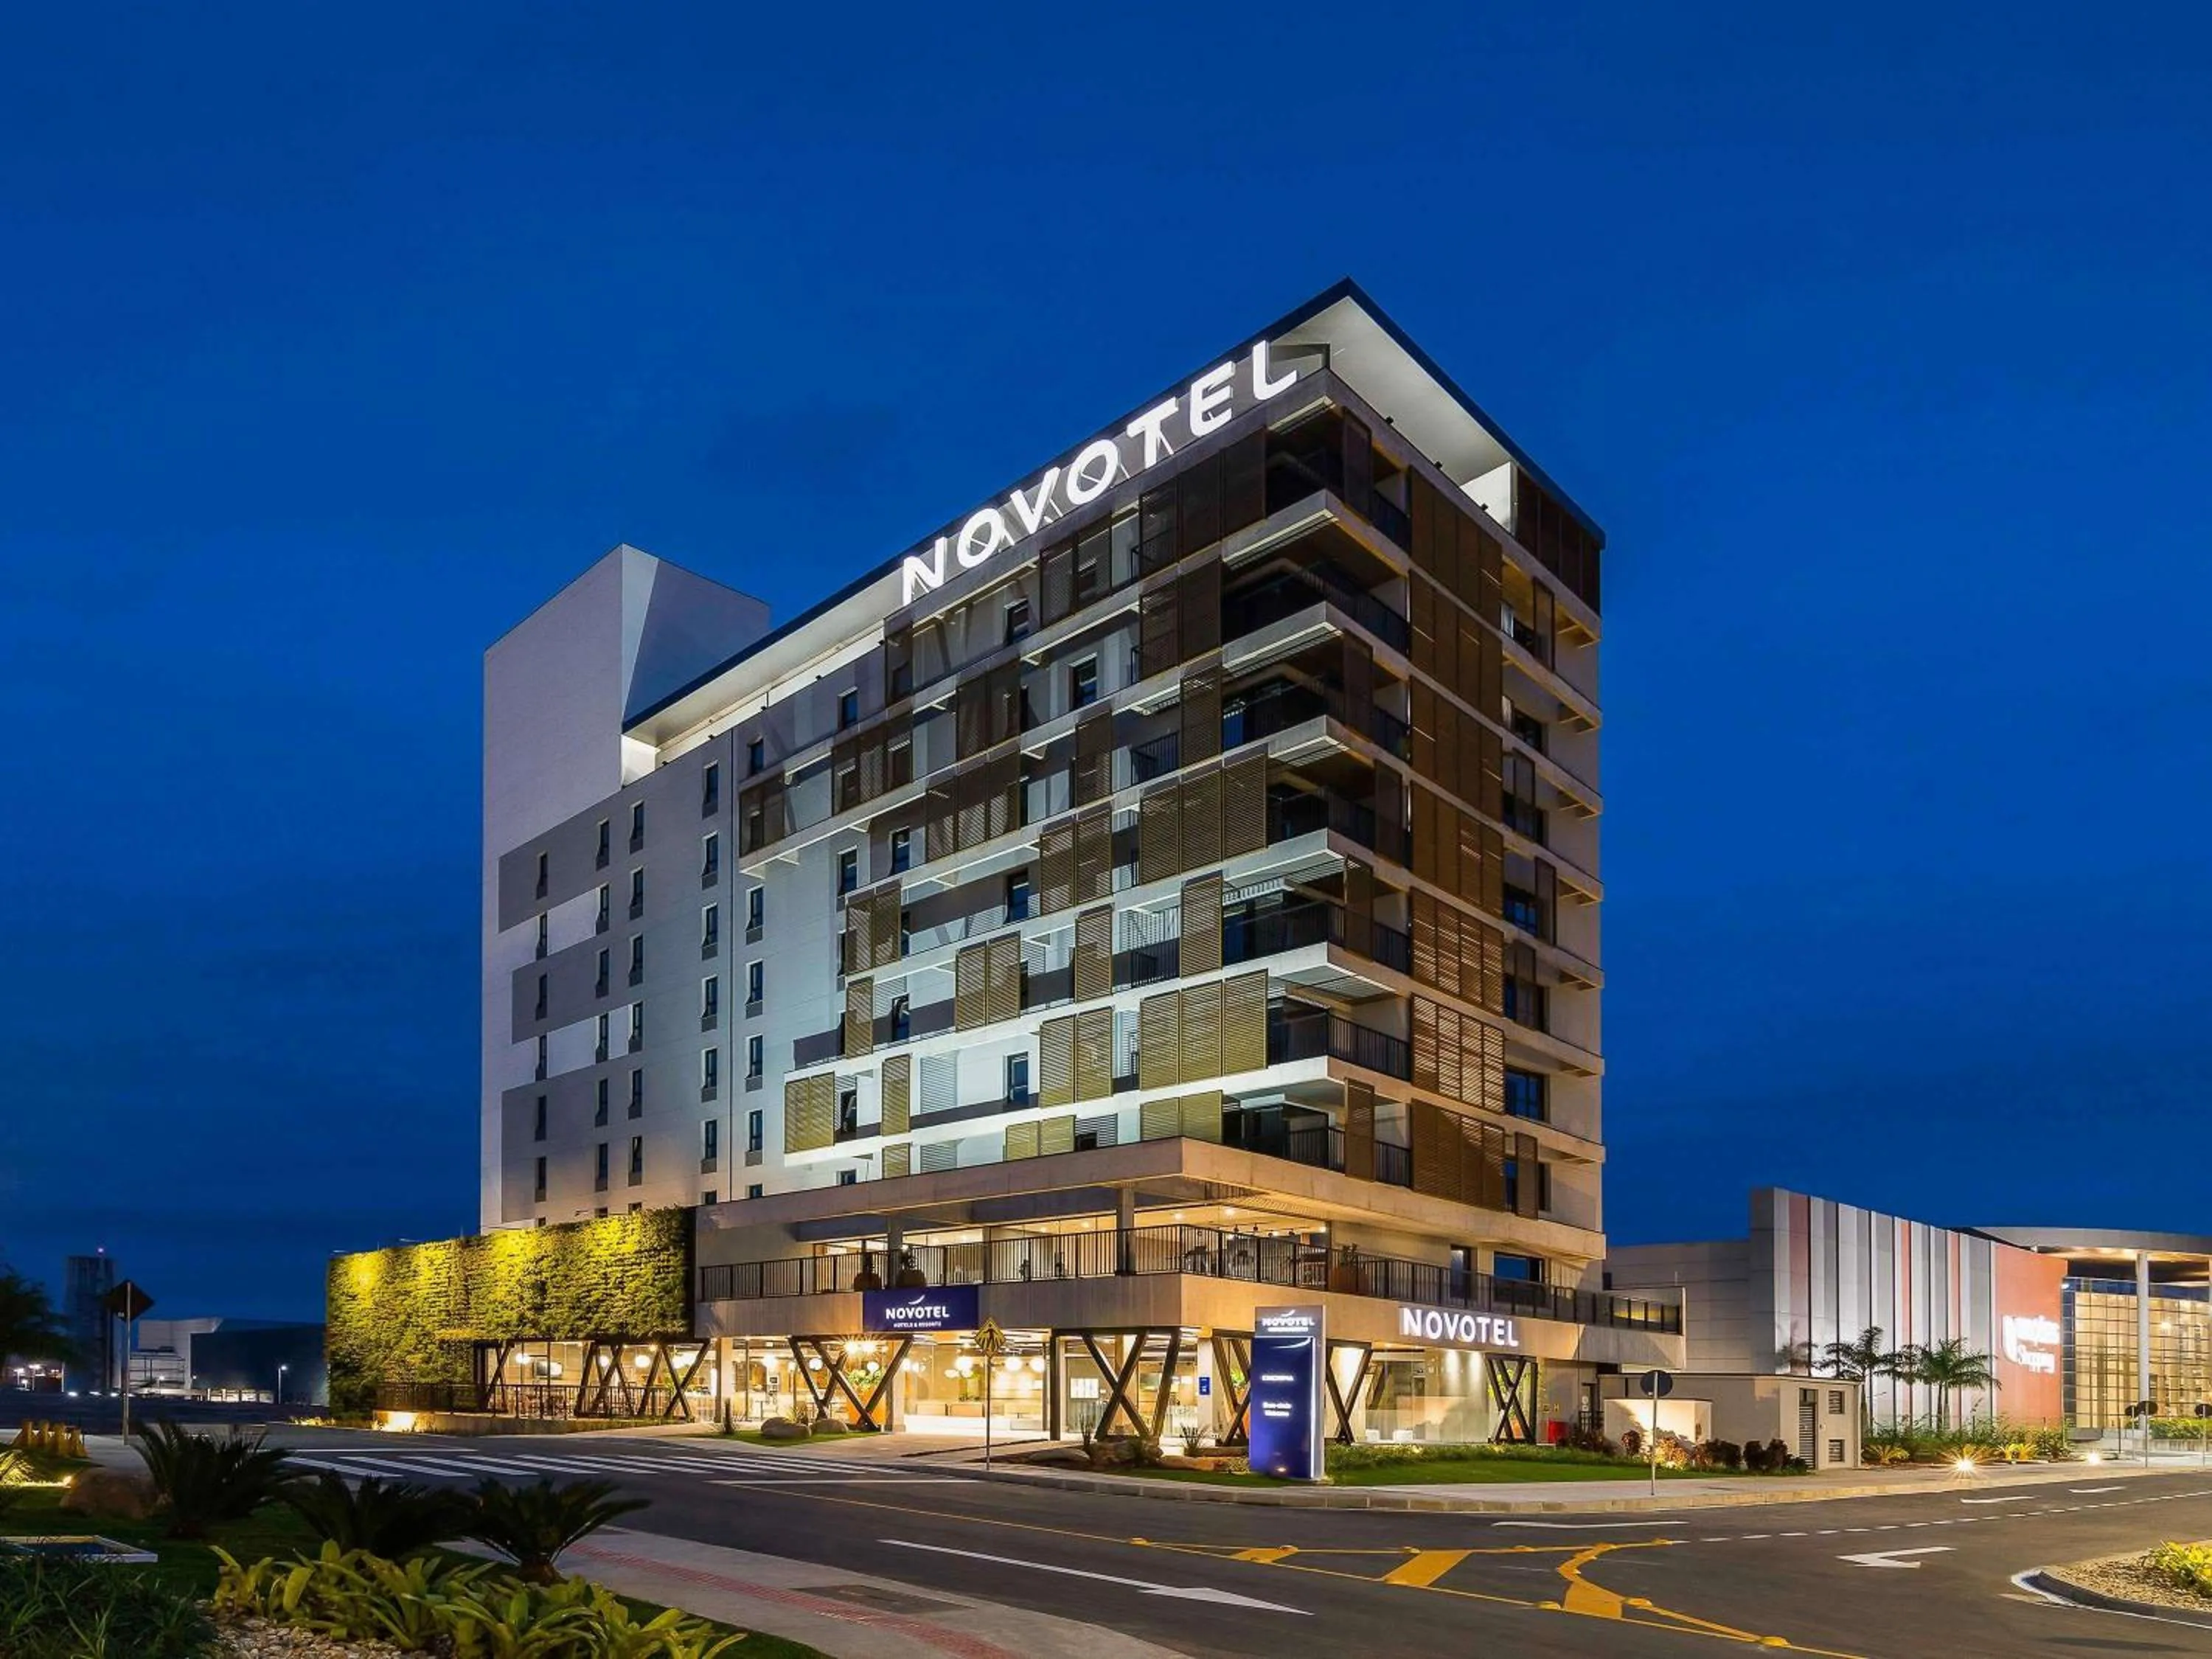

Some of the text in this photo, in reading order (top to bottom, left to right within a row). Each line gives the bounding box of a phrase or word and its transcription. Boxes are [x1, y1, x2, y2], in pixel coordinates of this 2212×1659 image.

[902, 340, 1297, 606] NOVOTEL
[886, 1306, 950, 1319] NOVOTEL
[1262, 1317, 1315, 1326] NOVOTEL
[1402, 1307, 1519, 1347] NOVOTEL
